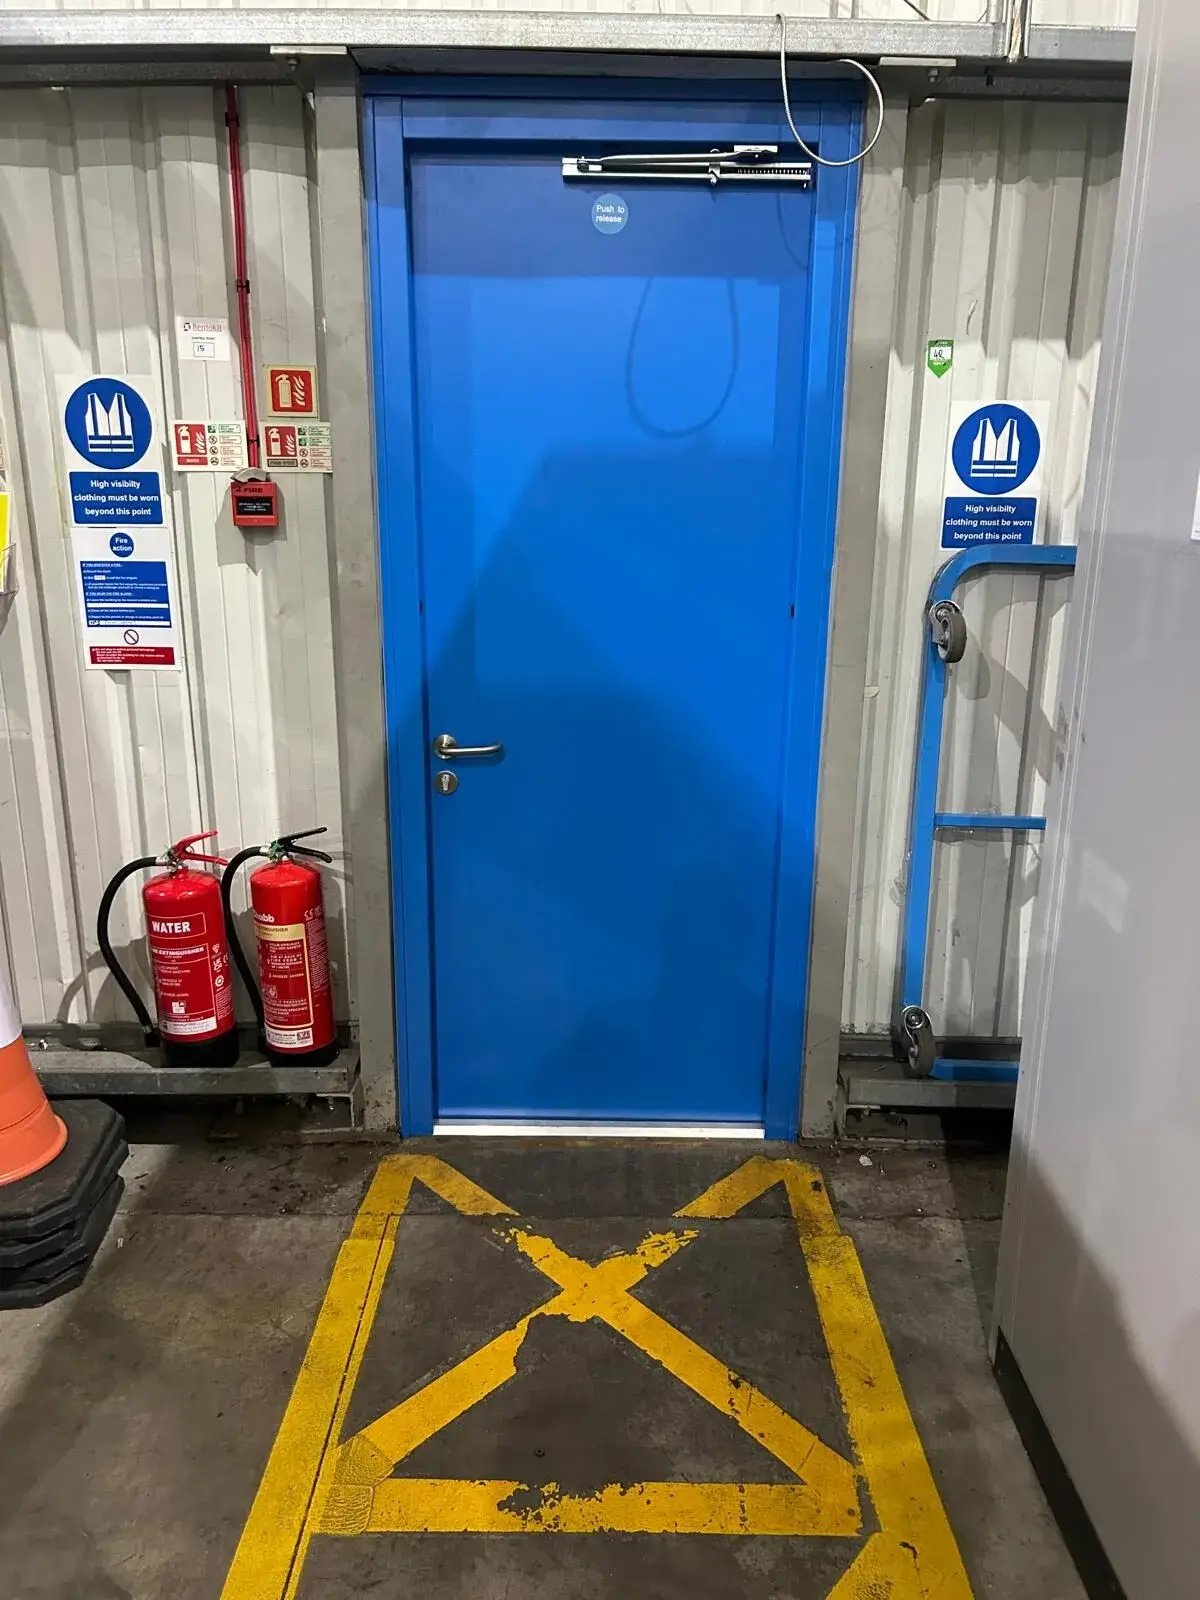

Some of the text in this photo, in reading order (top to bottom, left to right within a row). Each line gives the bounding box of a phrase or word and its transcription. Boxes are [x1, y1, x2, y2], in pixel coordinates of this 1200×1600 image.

[596, 204, 625, 214] Push to
[595, 214, 622, 223] release
[90, 480, 141, 489] High visibilty
[74, 494, 106, 503] clothing
[85, 508, 114, 516] beyond
[132, 508, 151, 516] point
[965, 505, 1016, 514] High visibilty
[945, 518, 978, 527] clothing
[954, 532, 983, 540] beyond
[1001, 532, 1022, 541] point
[151, 920, 191, 933] WATER
